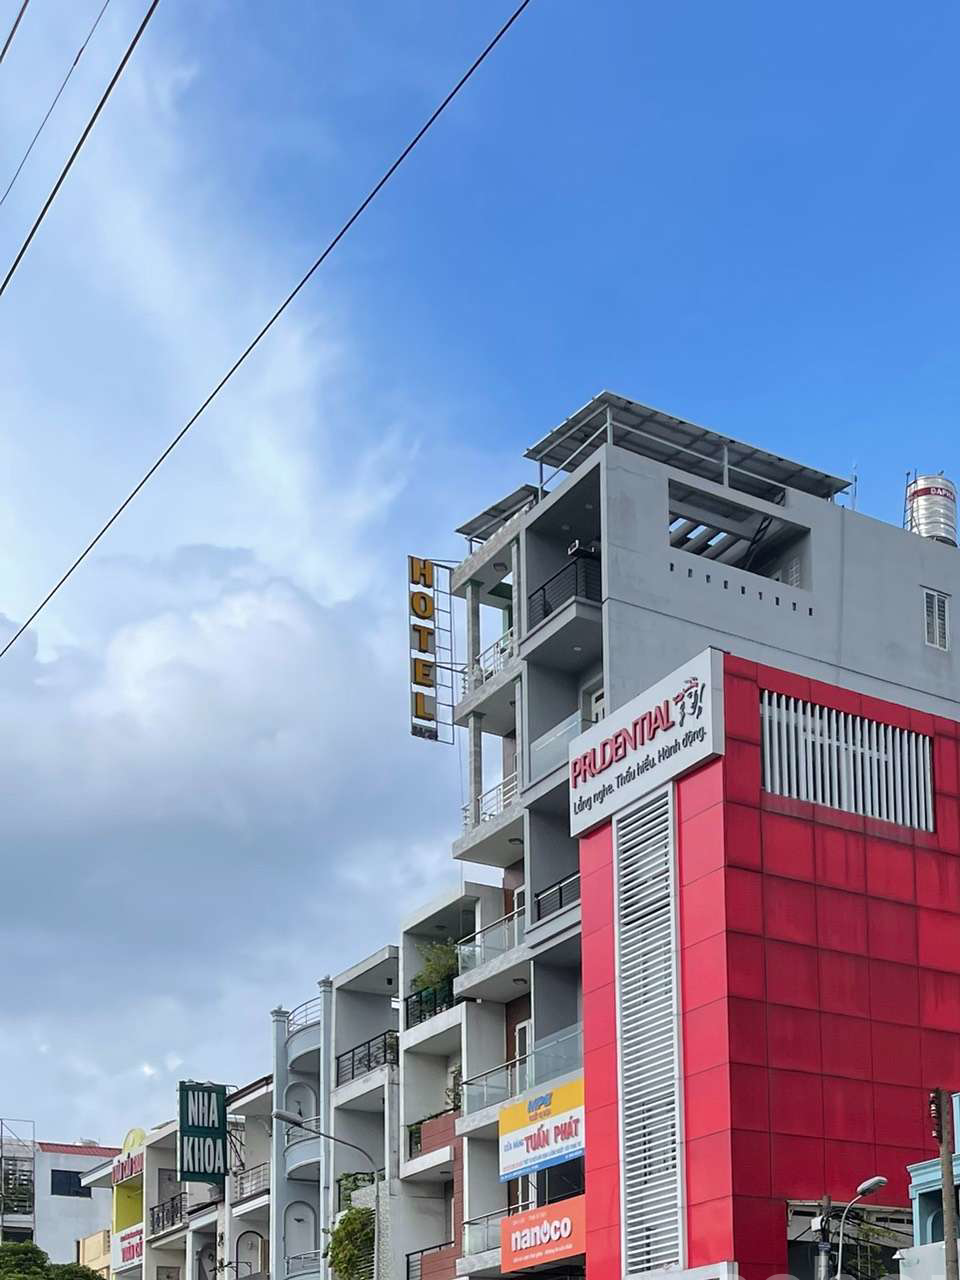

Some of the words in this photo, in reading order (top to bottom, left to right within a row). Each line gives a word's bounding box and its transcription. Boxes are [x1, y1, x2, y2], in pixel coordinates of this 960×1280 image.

[410, 558, 436, 721] HOTEL
[571, 700, 676, 789] PRUDENTIAL
[615, 766, 637, 790] Thấu
[657, 738, 681, 763] Hành
[681, 726, 708, 748] động.
[188, 1091, 219, 1128] NHA
[553, 1115, 580, 1144] PHÁT
[183, 1136, 224, 1174] KHOA
[511, 1217, 572, 1252] nanoco
